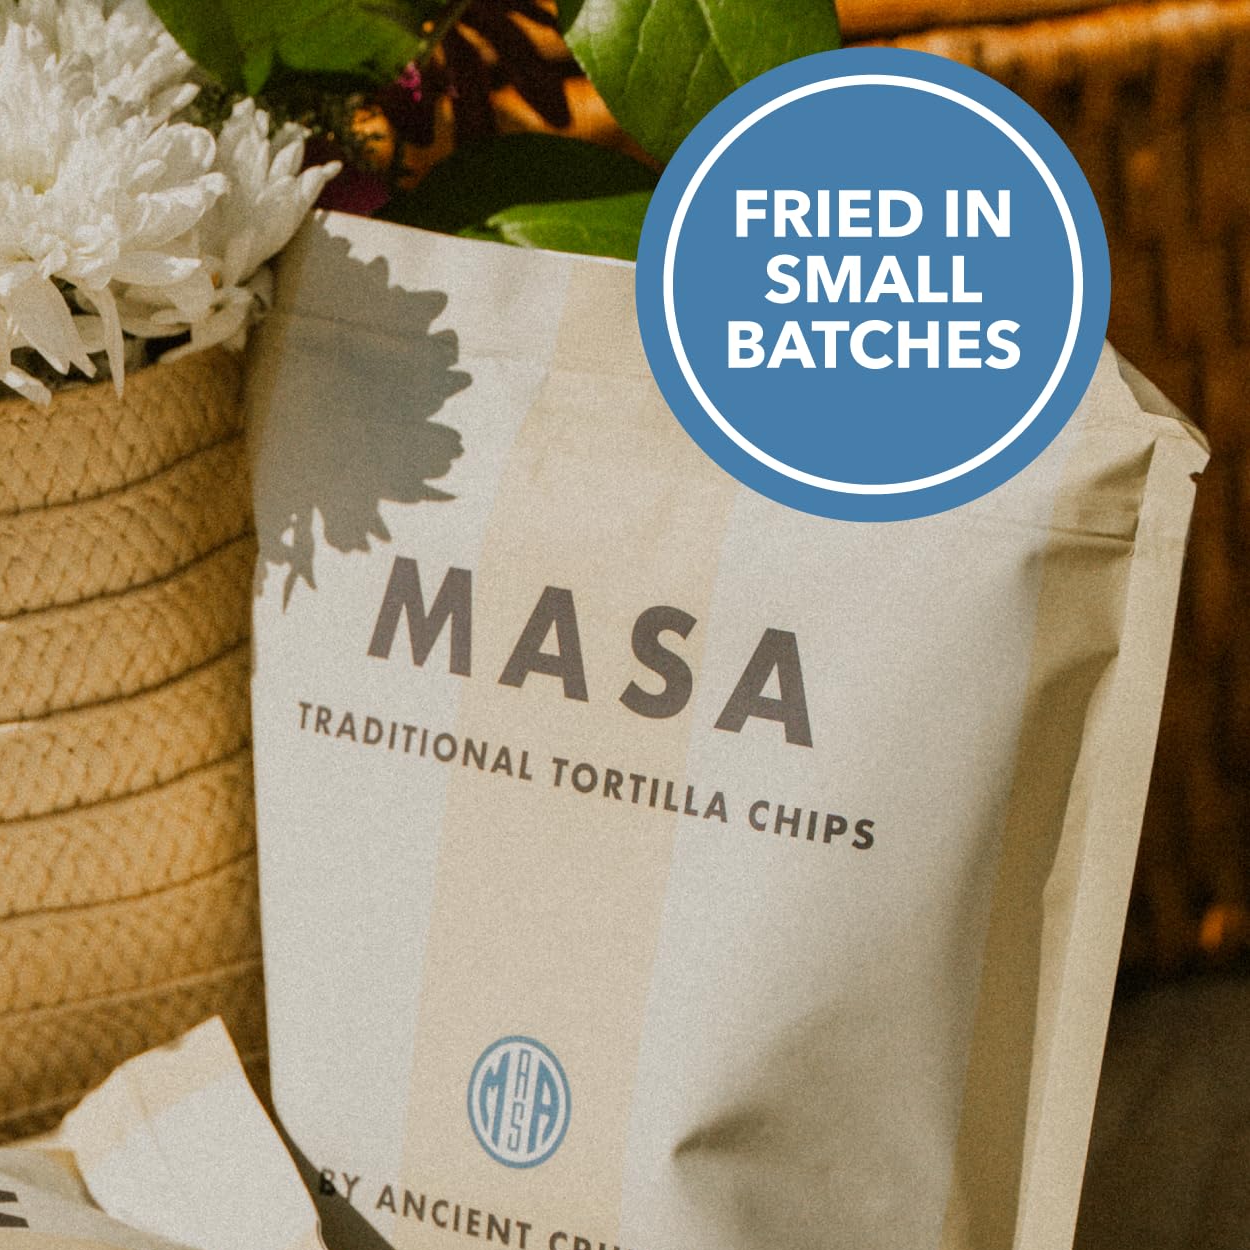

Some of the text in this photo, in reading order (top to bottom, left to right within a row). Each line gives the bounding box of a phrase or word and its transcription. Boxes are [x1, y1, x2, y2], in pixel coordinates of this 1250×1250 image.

[366, 555, 814, 749] MASA
[298, 701, 876, 850] TRADITIONAL TORTILLA CHIPS
[318, 1168, 361, 1200] BY
[375, 1184, 532, 1249] ANCIENT
